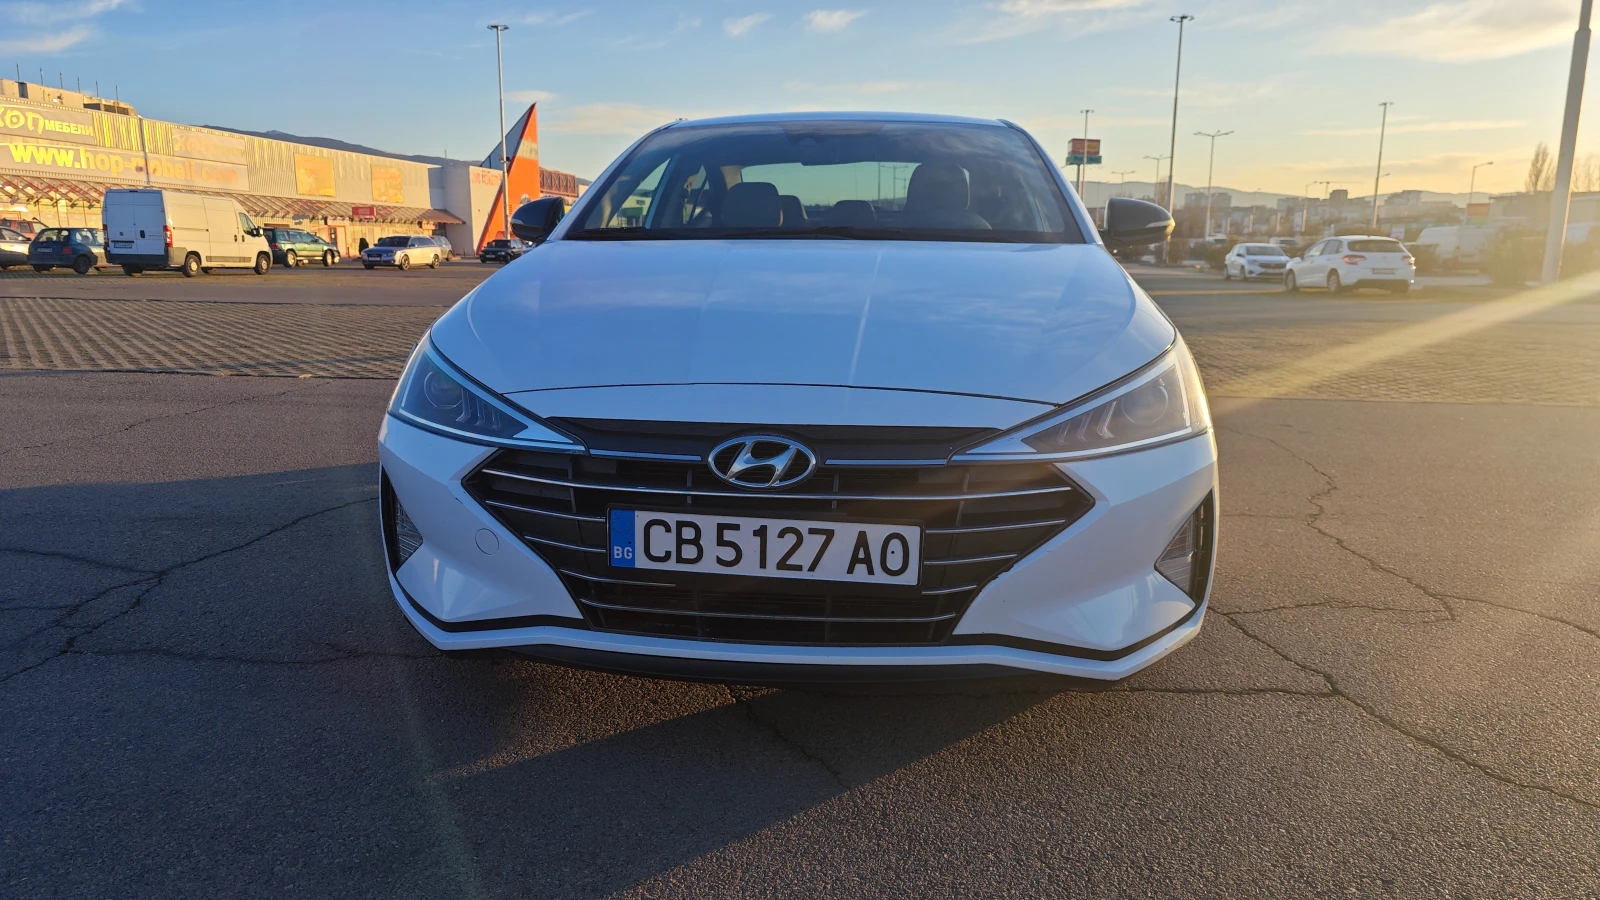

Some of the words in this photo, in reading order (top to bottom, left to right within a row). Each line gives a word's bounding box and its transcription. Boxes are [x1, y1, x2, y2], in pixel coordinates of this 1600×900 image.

[45, 119, 93, 136] МЕБЕЛИ
[613, 546, 633, 560] BG
[643, 519, 704, 564] CB
[716, 522, 836, 572] 5127
